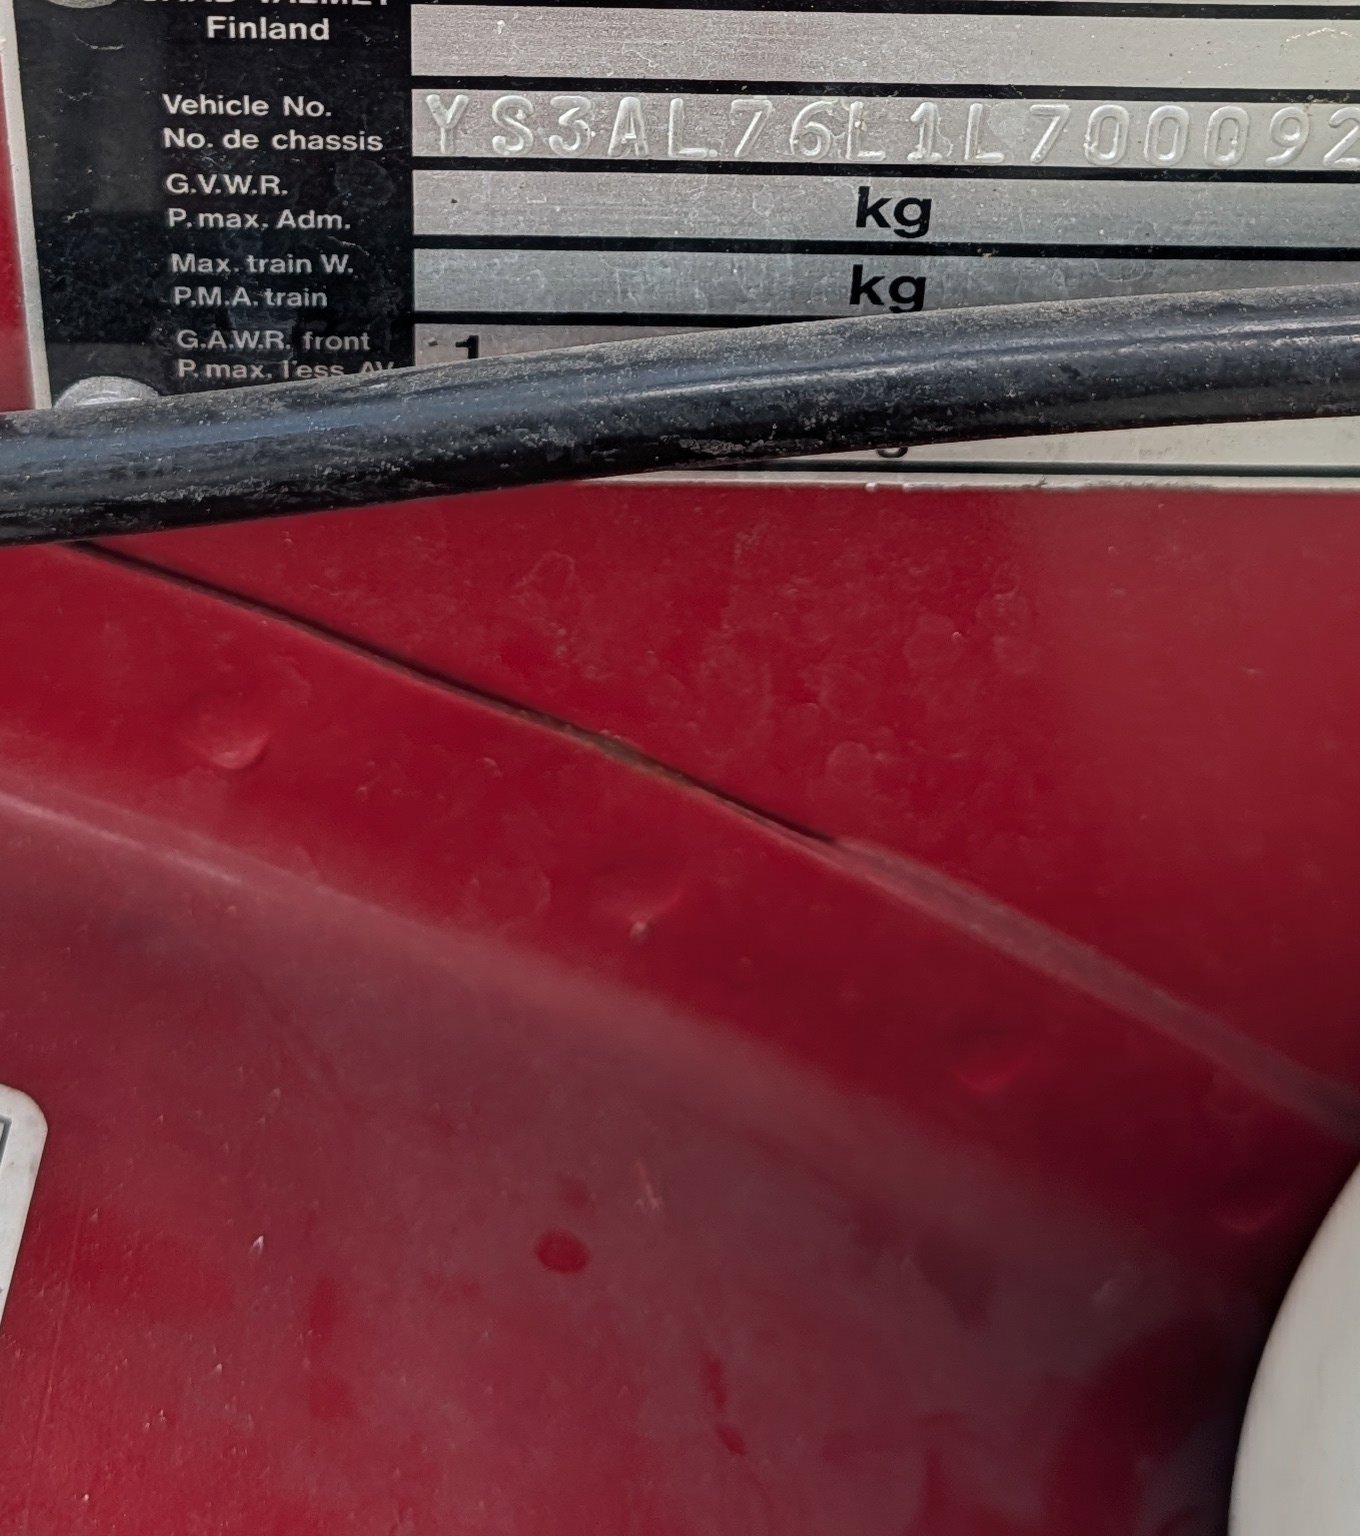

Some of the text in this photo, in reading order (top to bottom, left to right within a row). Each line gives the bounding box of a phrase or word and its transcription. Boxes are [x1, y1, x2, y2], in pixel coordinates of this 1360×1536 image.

[207, 16, 329, 40] Finland
[162, 94, 331, 116] Vehicle No.
[163, 128, 383, 151] No. de chassis
[166, 173, 288, 195] G.V.W.R.
[276, 209, 350, 229] Adm.
[856, 186, 932, 238] kg
[171, 253, 353, 273] Max. train W.
[174, 287, 327, 307] P.M.A. train
[849, 265, 926, 313] kg
[177, 330, 370, 350] G.A.W.R. front
